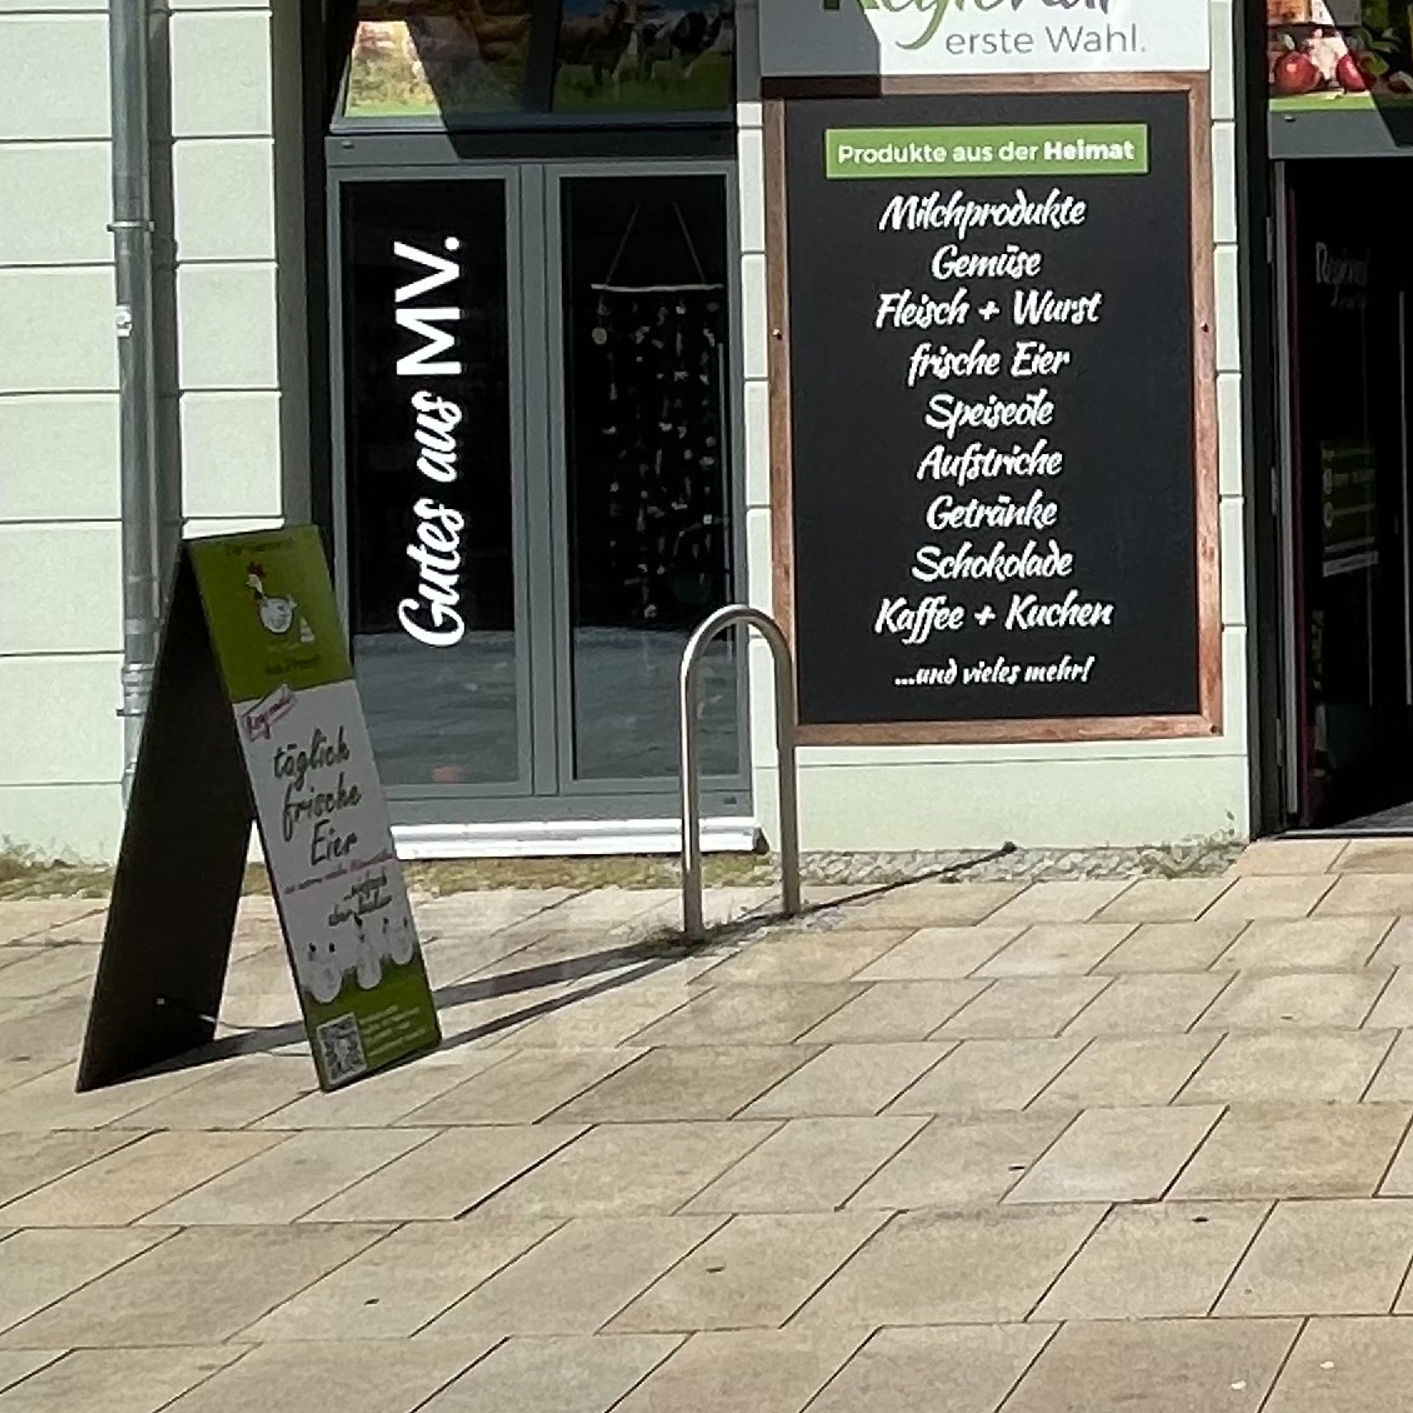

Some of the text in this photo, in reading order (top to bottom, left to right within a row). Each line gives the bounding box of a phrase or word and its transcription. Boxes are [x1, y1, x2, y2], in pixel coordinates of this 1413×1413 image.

[945, 23, 1145, 55] erste Wahl.
[838, 138, 1135, 164] Produkte aus der Heimat
[878, 187, 1086, 240] Milchprodukte
[931, 243, 1042, 280] Gemüse
[875, 287, 1102, 329] Fleisch + Wurst
[907, 338, 1070, 387] frische Eier
[925, 388, 1054, 439] Speiseöle
[393, 236, 465, 646] Gutes aus MV.
[916, 437, 1063, 487] Aufstriche
[926, 488, 1058, 530] Getränke
[911, 539, 1073, 582] Schokolade
[874, 589, 1114, 645] Kaffee + Kuchen
[963, 656, 1021, 685] vieles
[1024, 655, 1095, 682] mehr!
[273, 725, 351, 791] täglich
[283, 771, 363, 842] frische
[311, 818, 358, 866] Eier
